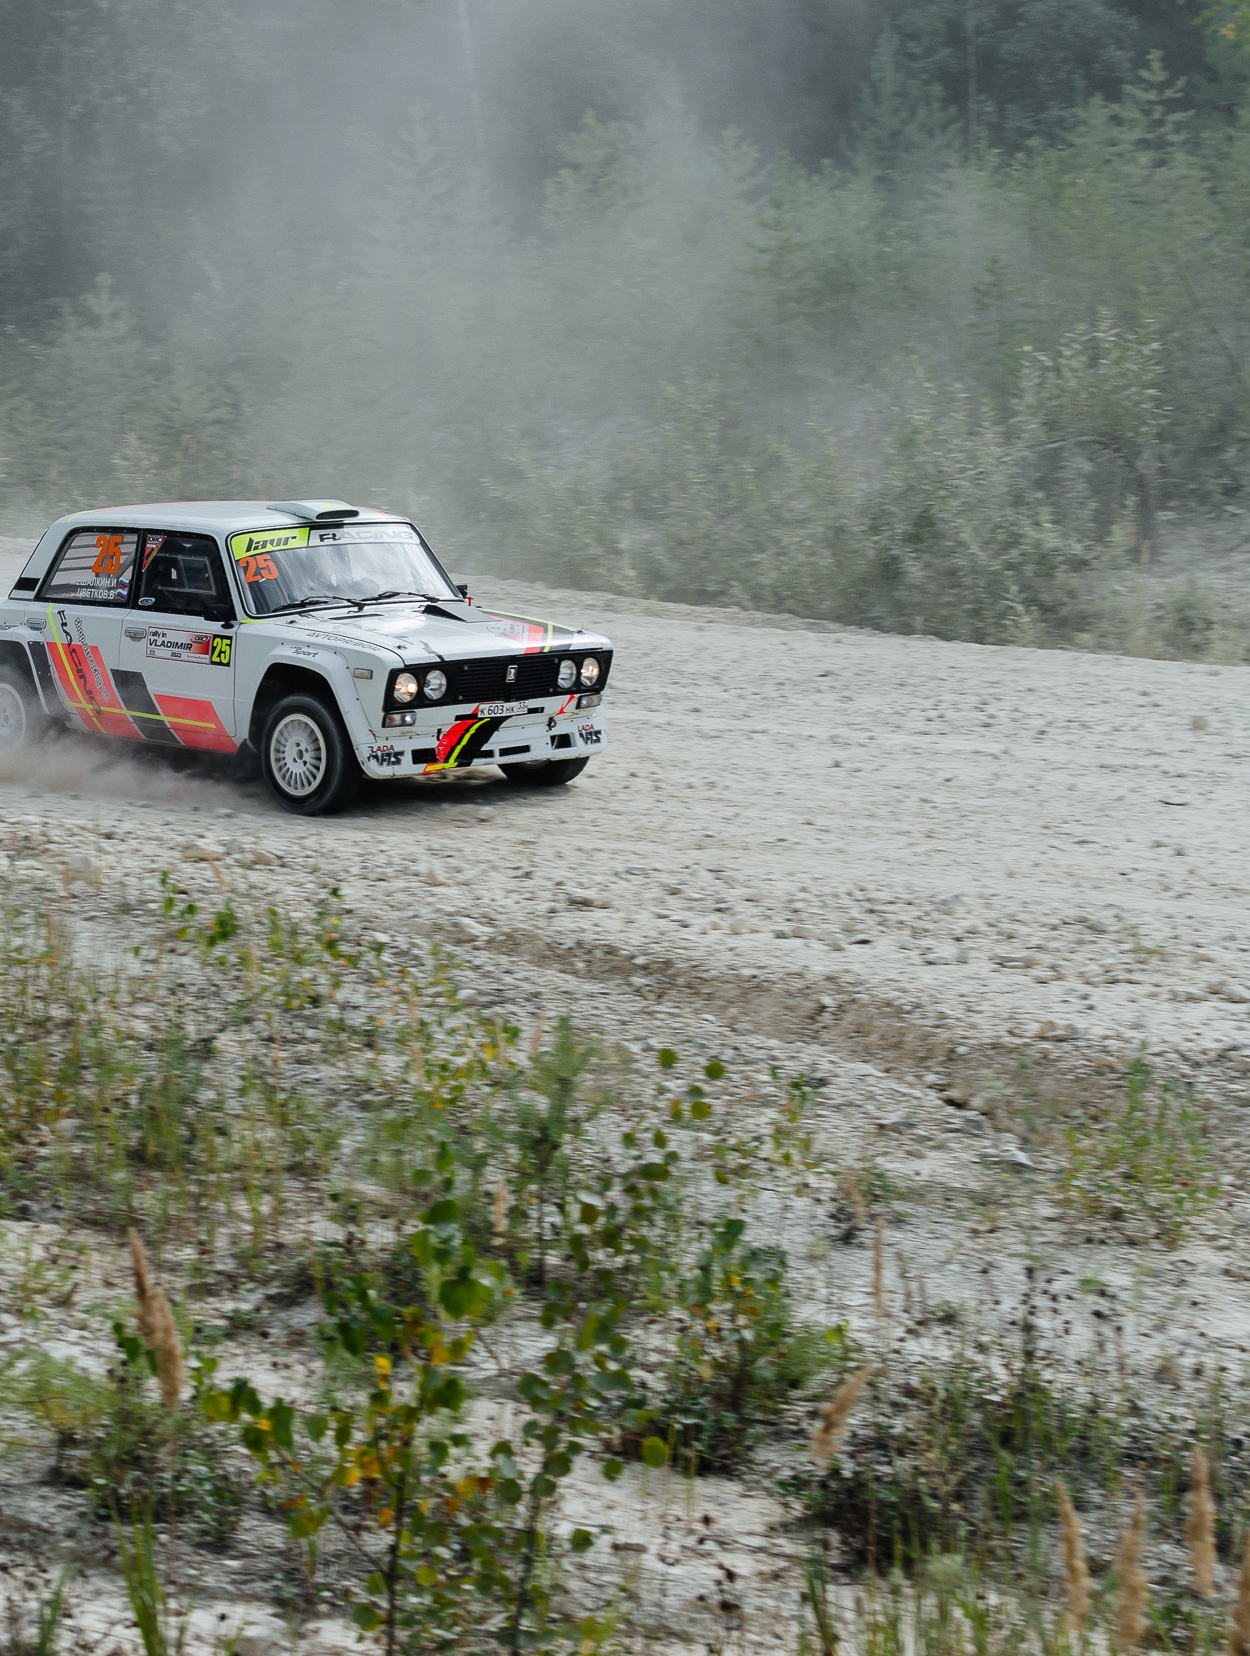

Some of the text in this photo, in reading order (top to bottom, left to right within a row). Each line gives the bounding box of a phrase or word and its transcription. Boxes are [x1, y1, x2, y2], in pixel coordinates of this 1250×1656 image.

[319, 531, 413, 542] RACING
[92, 534, 123, 575] 25
[239, 555, 278, 582] 25
[149, 639, 193, 651] VLADIMIR
[212, 637, 231, 664] 25
[487, 705, 504, 715] 603
[578, 724, 595, 732] LADA
